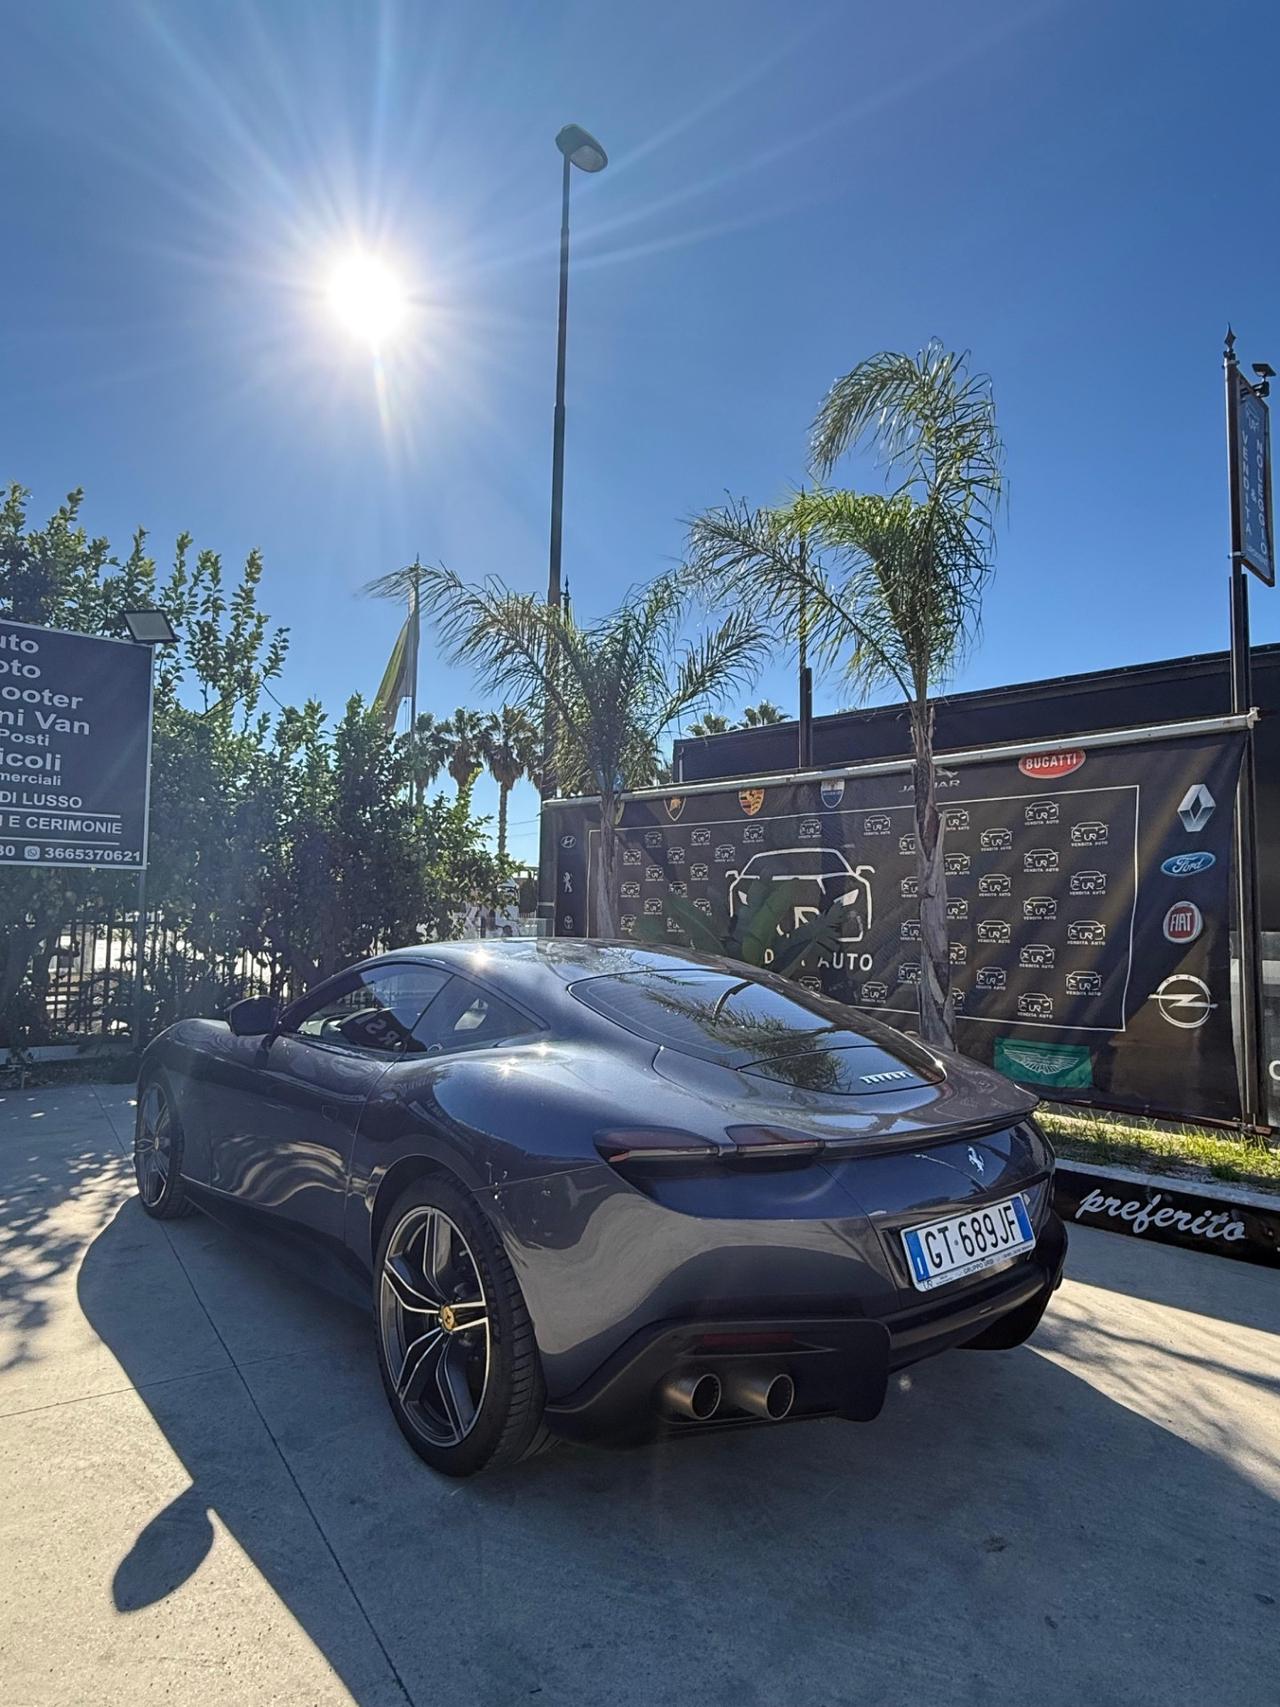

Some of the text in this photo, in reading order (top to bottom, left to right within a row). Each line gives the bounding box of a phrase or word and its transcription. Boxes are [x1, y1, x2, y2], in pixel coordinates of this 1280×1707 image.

[2, 687, 83, 709] ooter
[35, 711, 89, 735] Van
[0, 728, 49, 746] Posti
[1025, 753, 1077, 770] BUGATTI
[898, 780, 960, 792] JAAR
[0, 791, 82, 808] DI LUSSO
[9, 816, 20, 827] E
[26, 817, 122, 834] CERIMONIE
[45, 847, 140, 862] 3665370621
[1172, 856, 1204, 872] Ford
[1170, 912, 1192, 932] FIAT
[1075, 1189, 1245, 1241] preferito
[925, 1226, 954, 1268] GT
